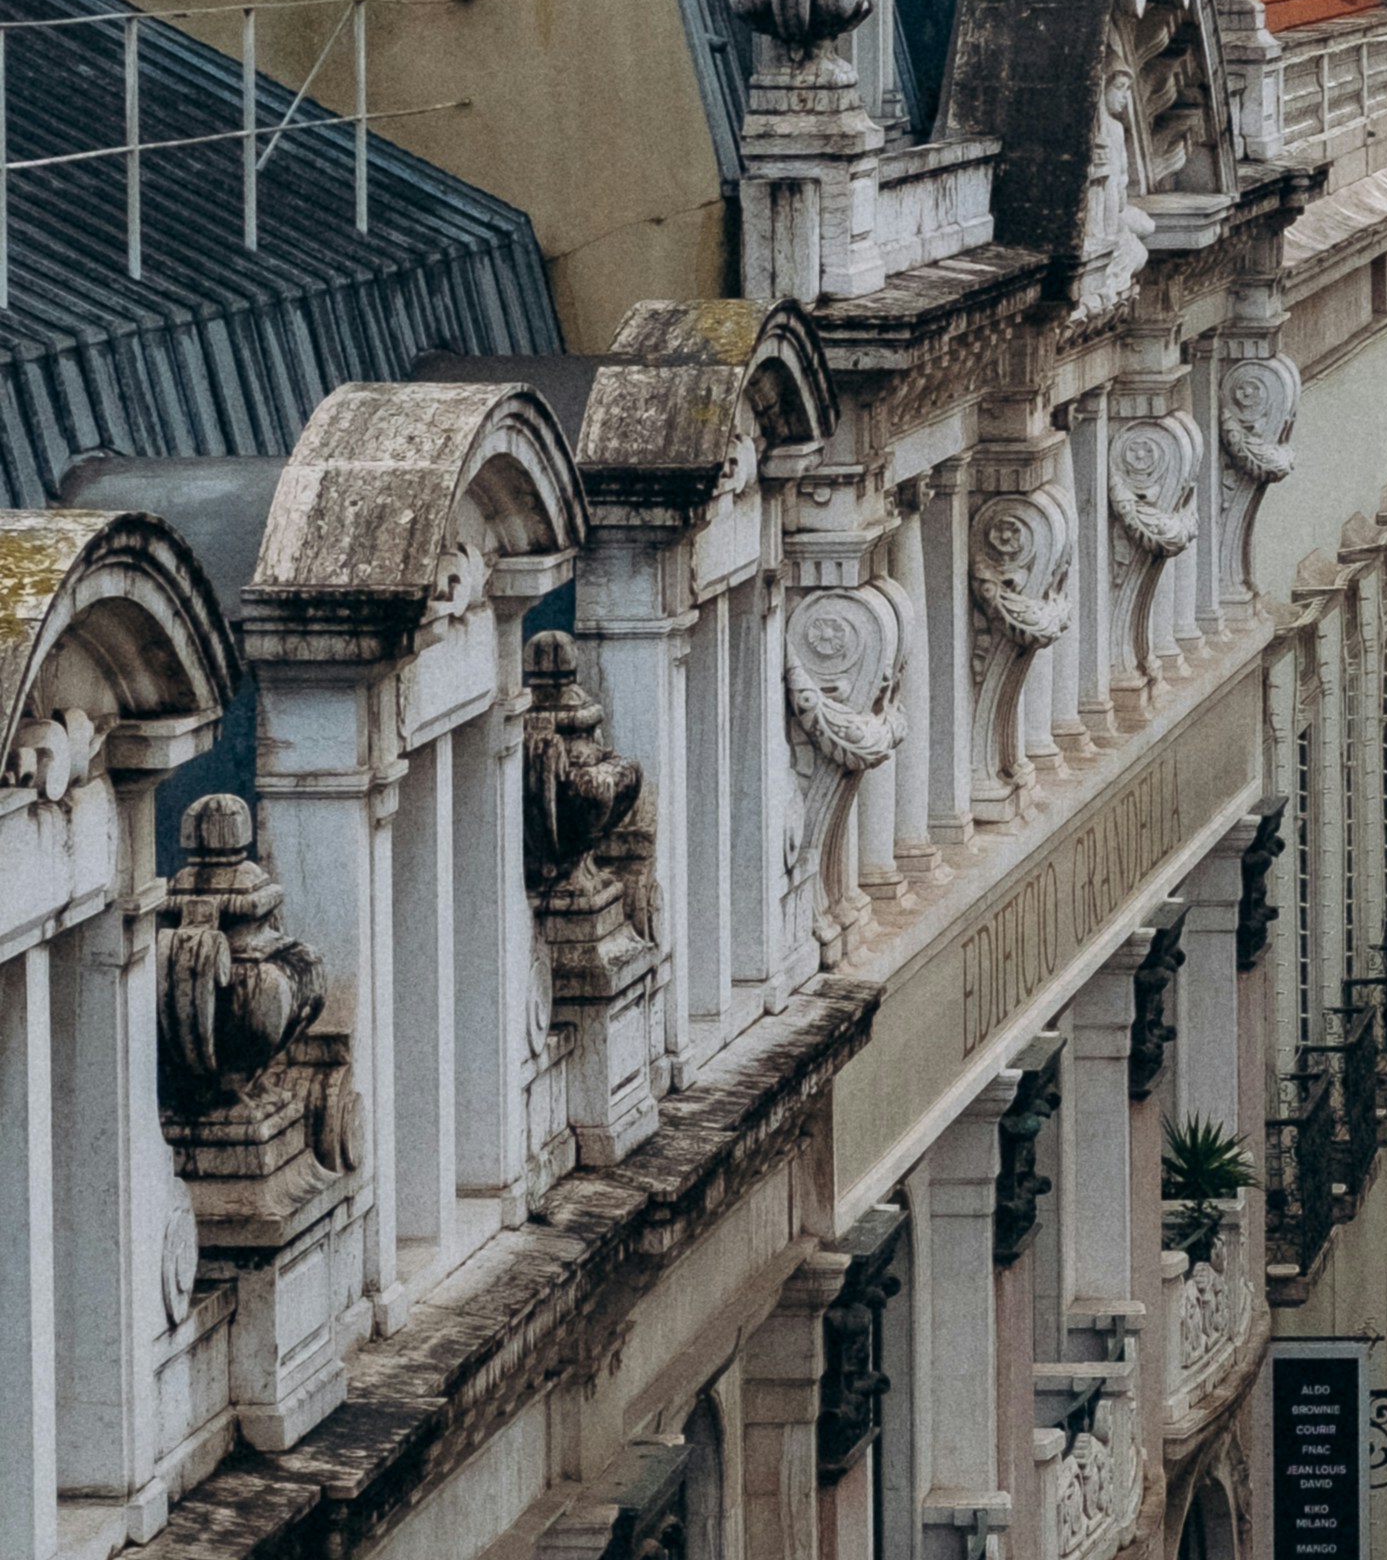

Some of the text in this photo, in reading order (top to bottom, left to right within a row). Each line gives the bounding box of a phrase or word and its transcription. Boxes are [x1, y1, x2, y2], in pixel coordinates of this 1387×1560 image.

[1301, 1385, 1330, 1395] ALDO
[1296, 1424, 1336, 1435] COURIR
[1302, 1445, 1331, 1454] FNAC
[1288, 1465, 1347, 1475] JEAN LOUIS
[1300, 1479, 1333, 1489] DAVID
[1304, 1504, 1329, 1514] KIKO
[1296, 1518, 1337, 1528] MILANO
[1296, 1544, 1337, 1553] MANGO
